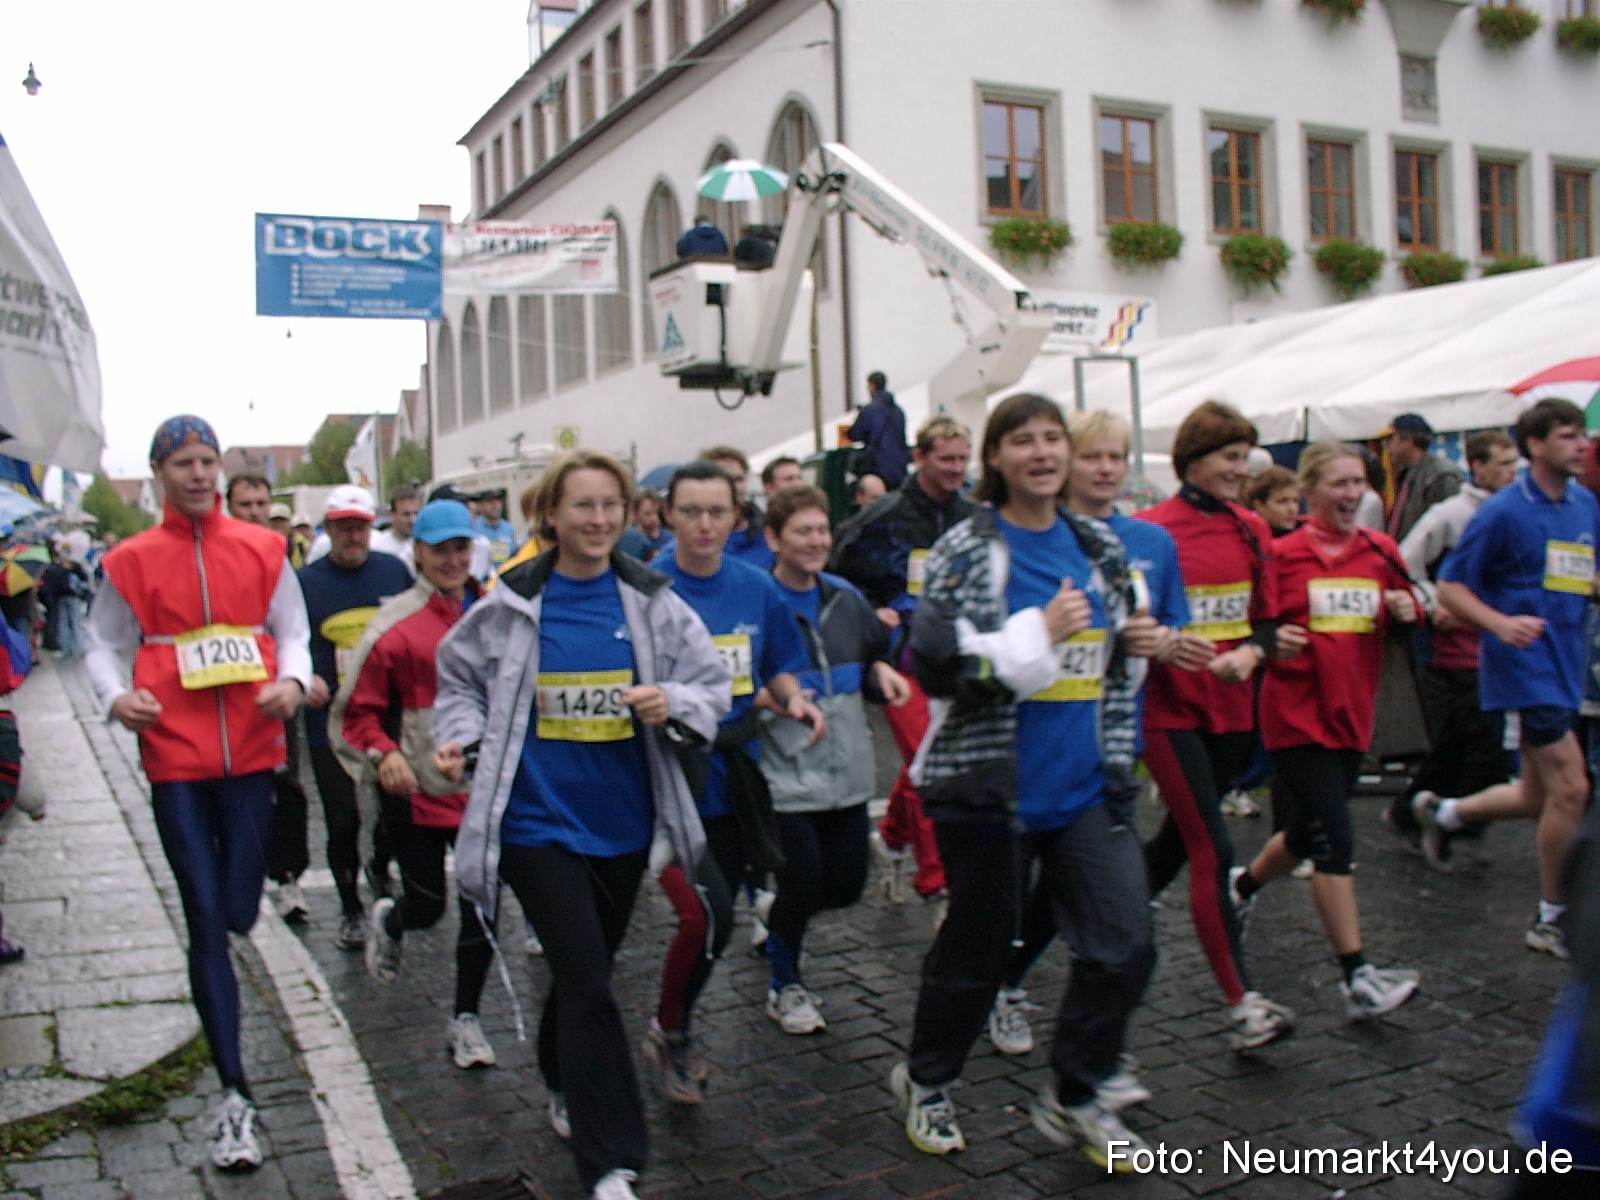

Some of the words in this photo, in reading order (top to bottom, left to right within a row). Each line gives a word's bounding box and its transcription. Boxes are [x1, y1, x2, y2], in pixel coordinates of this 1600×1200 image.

[265, 217, 432, 260] BOCK
[194, 637, 255, 666] 1203
[1054, 645, 1097, 674] 421
[556, 688, 624, 716] 1429
